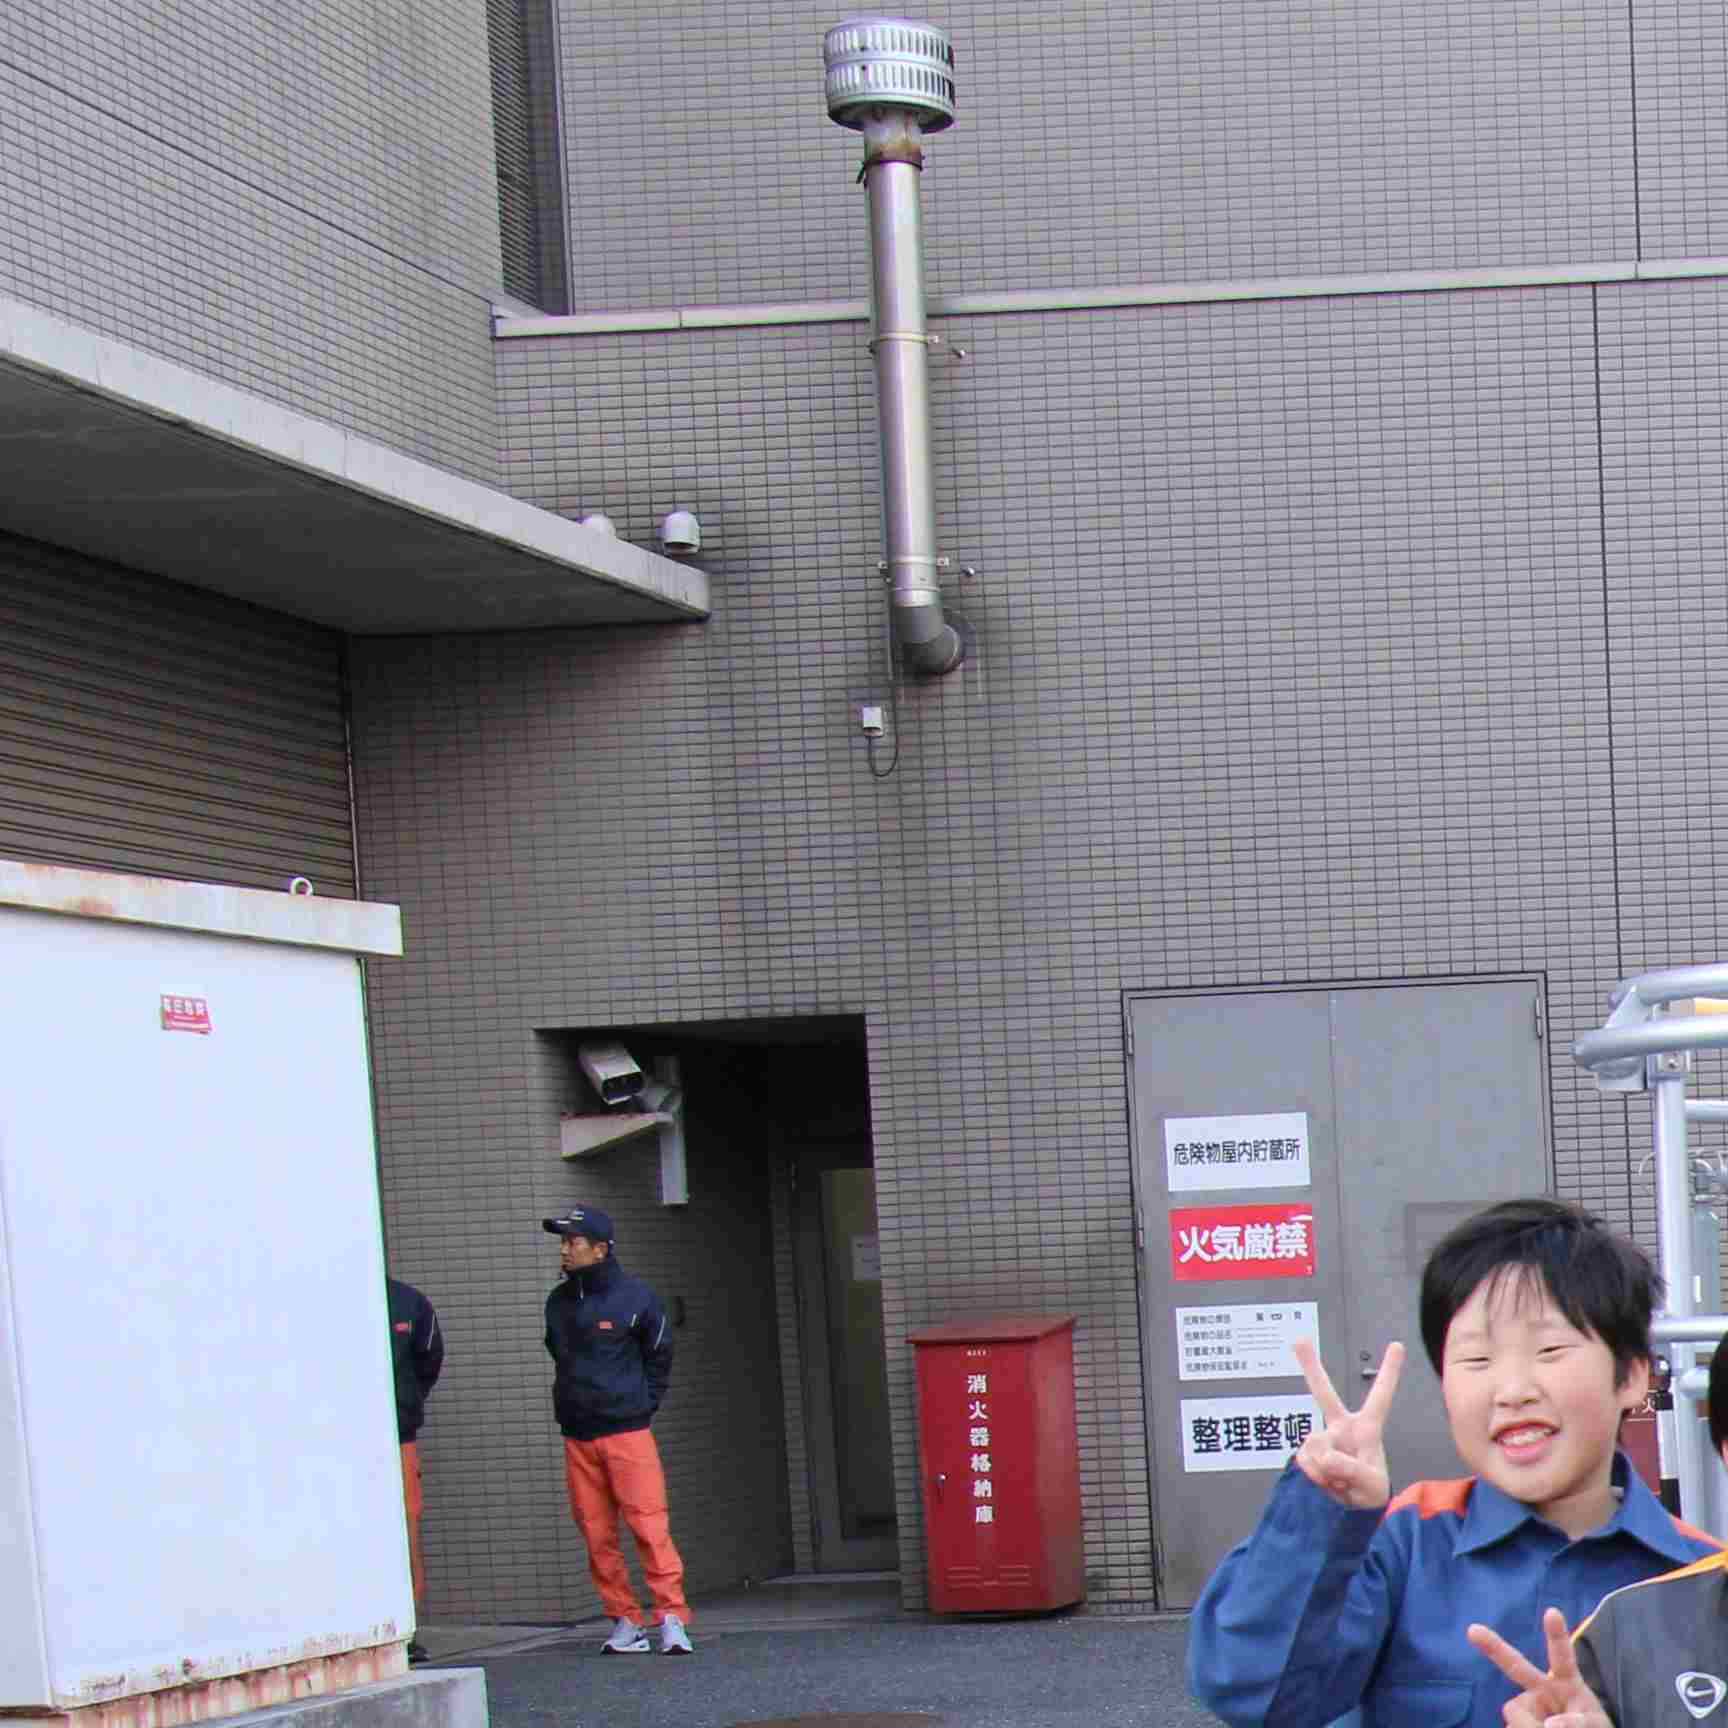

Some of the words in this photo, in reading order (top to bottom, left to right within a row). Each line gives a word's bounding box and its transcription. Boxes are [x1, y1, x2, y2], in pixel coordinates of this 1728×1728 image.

[1173, 1138, 1300, 1166] 危険物屋内貯蔵所
[1178, 1222, 1309, 1263] 火気厳禁
[966, 1374, 994, 1523] 消火器格納庫
[1191, 1413, 1312, 1454] 整理整頓
